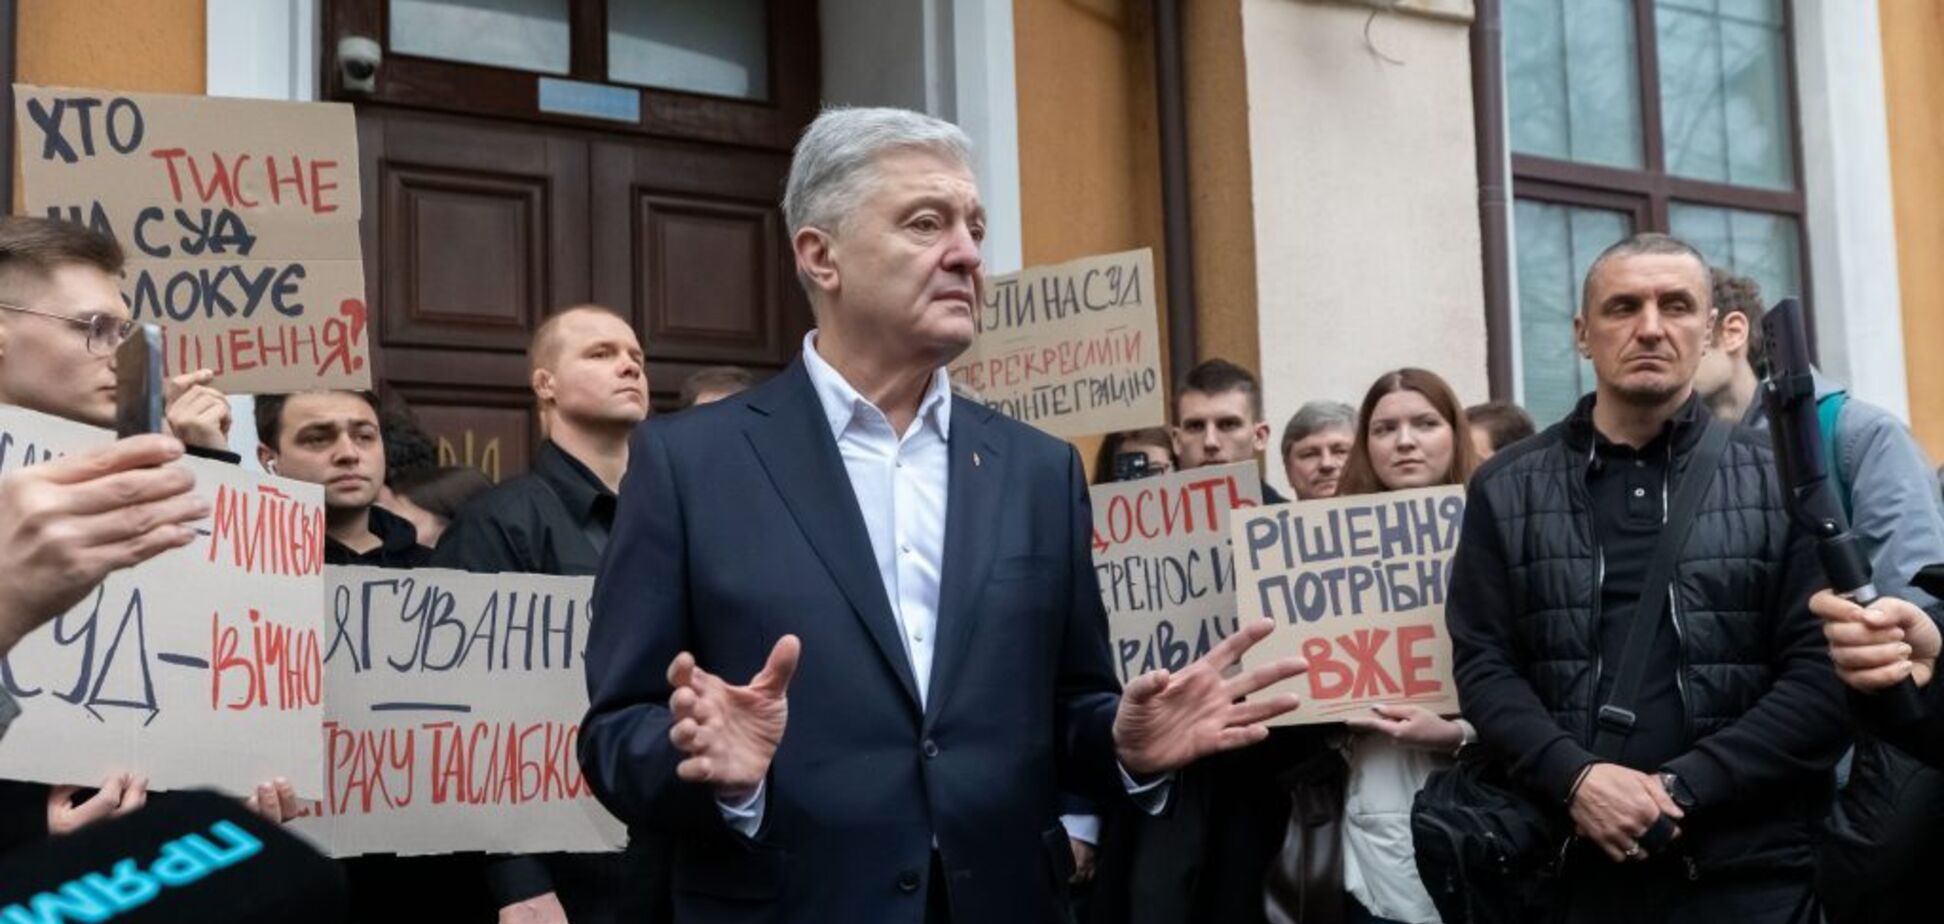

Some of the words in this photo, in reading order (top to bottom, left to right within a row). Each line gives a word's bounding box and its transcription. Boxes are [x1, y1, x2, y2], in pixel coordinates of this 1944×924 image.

[27, 96, 144, 163] ХТО
[120, 263, 306, 322] ЛОКУЄ
[161, 298, 367, 377] ІШЕННЯ?
[1246, 496, 1464, 571] РІШЕННЯ
[212, 608, 322, 711] ВІЧНО
[324, 577, 594, 673] ЯГУВАНН
[1303, 624, 1443, 701] ВЖЕ
